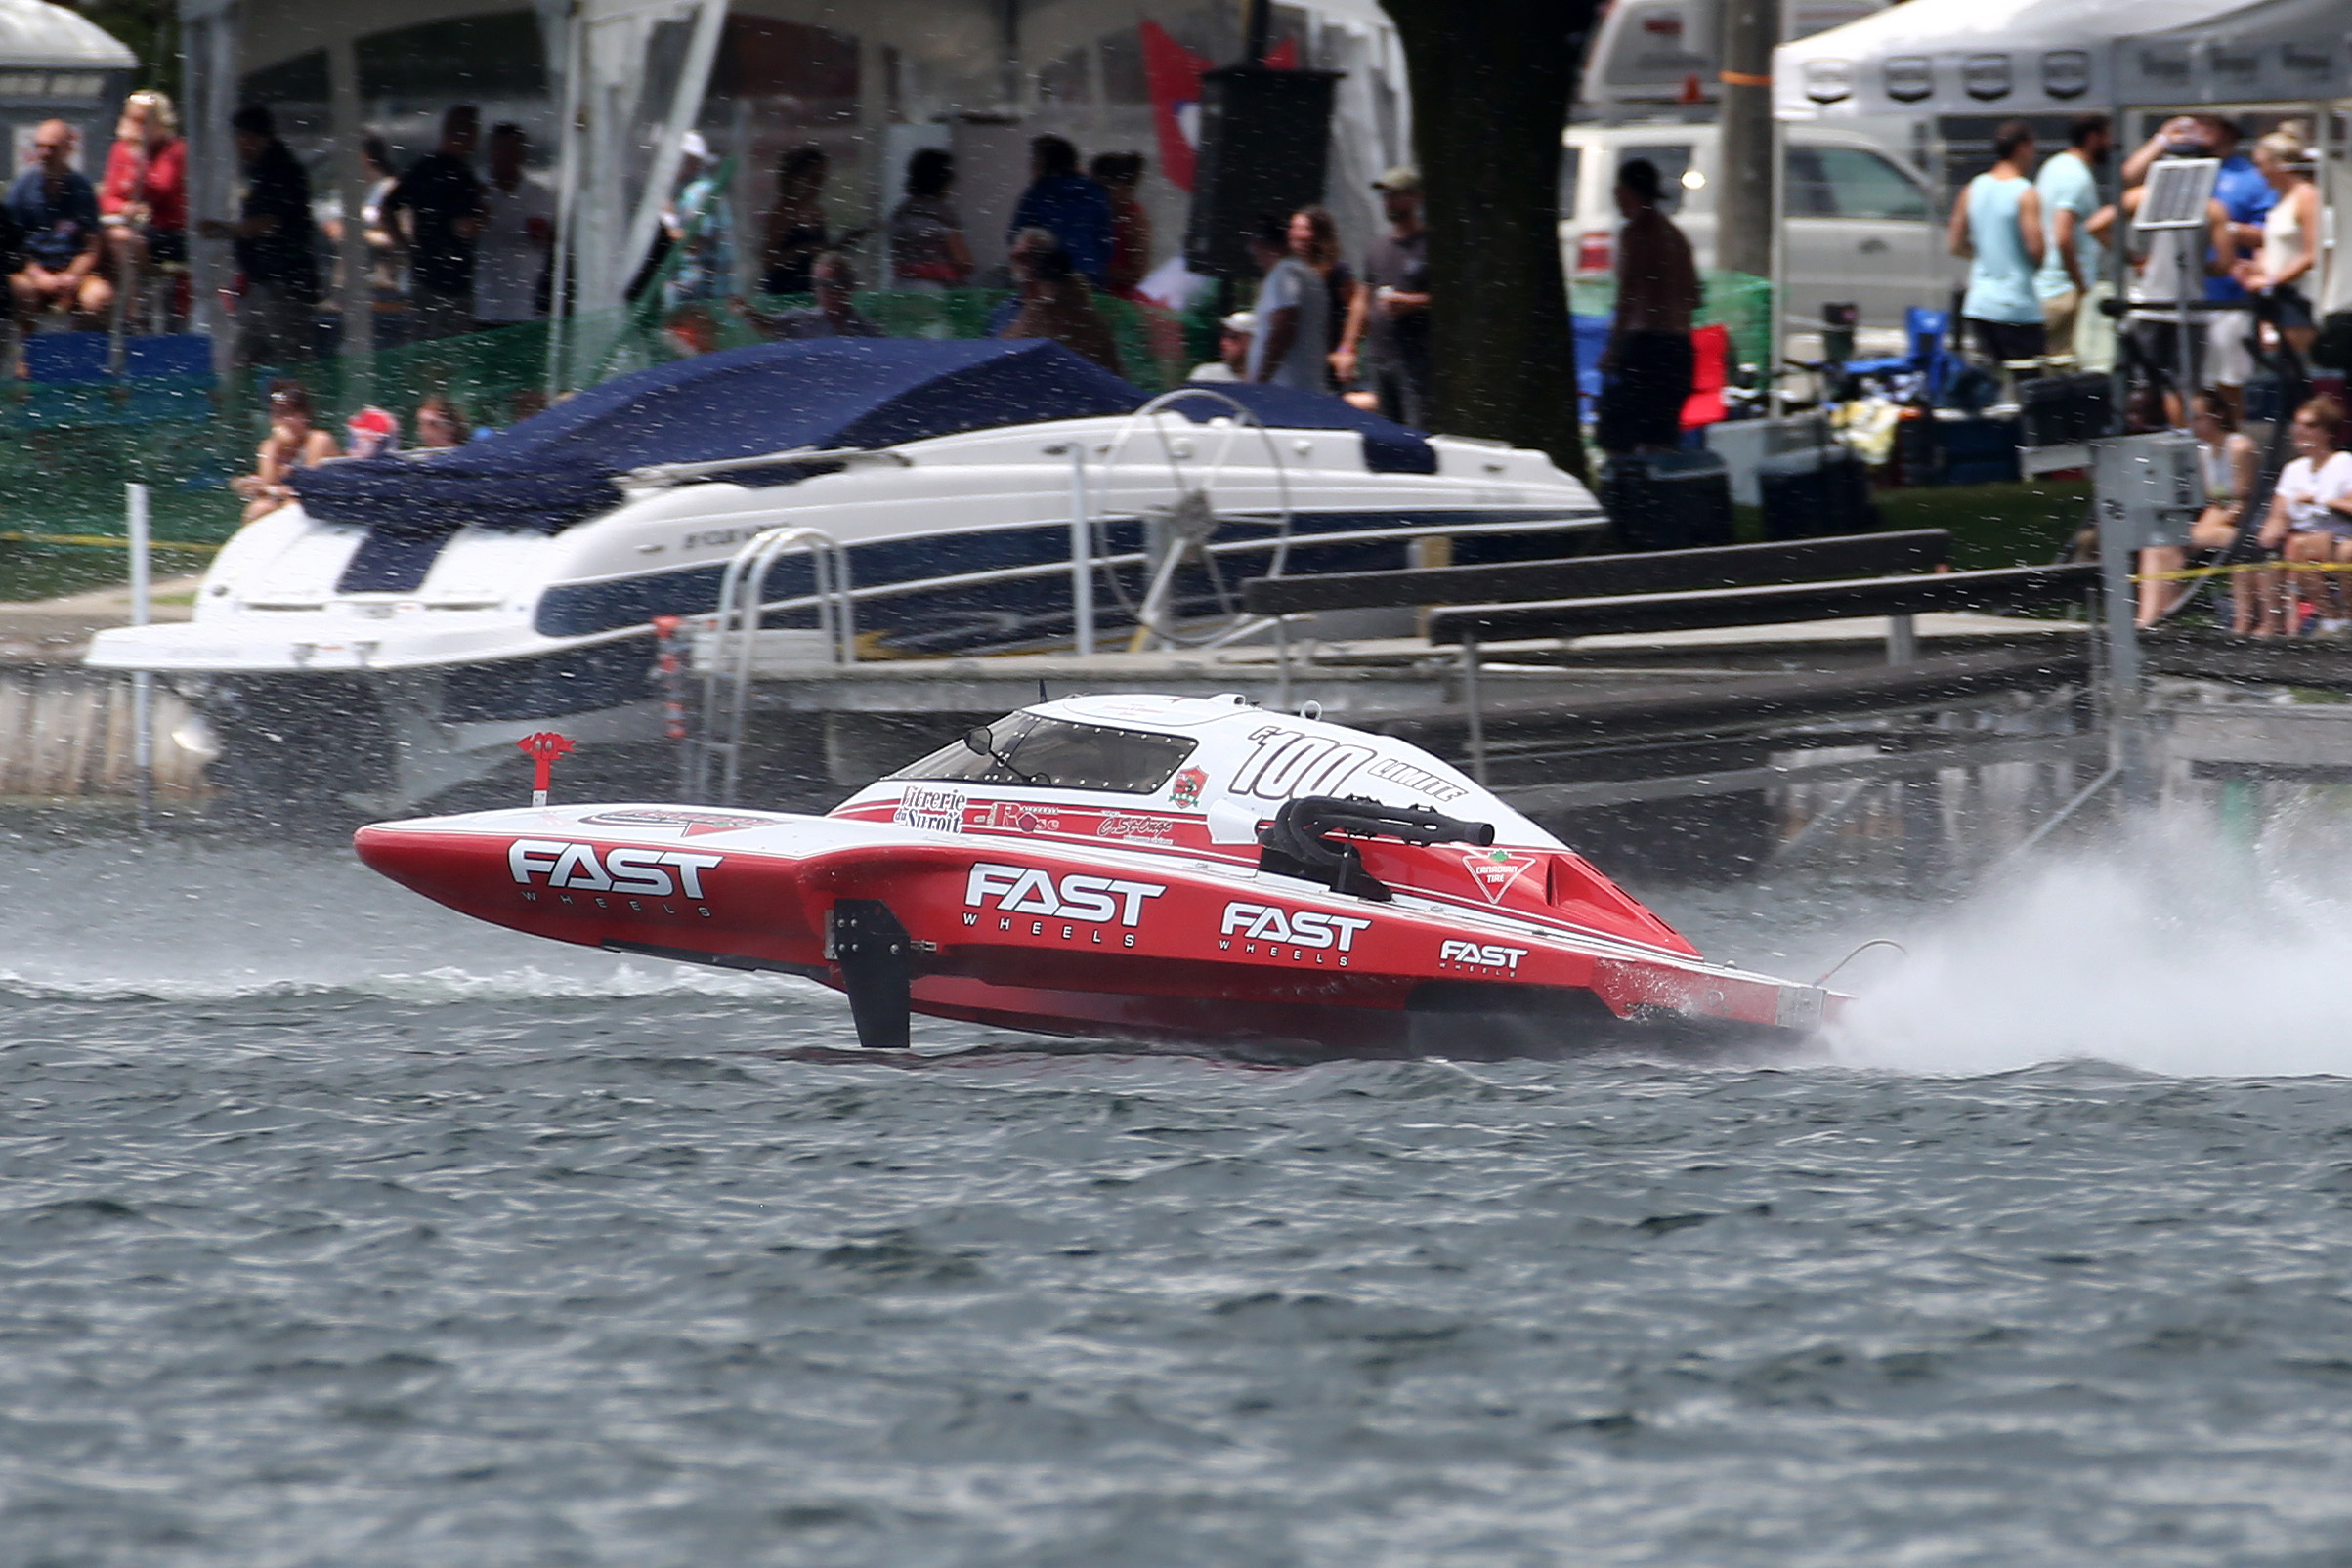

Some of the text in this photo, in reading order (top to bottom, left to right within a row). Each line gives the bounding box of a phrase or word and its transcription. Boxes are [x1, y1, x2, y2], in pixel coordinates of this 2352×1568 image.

[1368, 758, 1469, 803] LIMITE
[901, 785, 965, 811] Vitrerie
[895, 808, 907, 821] du
[508, 838, 724, 900] FAST
[1475, 866, 1518, 875] CANADIAN
[1486, 874, 1505, 883] TIRE
[521, 891, 712, 917] WHEELS
[964, 863, 1167, 927] FAST
[962, 912, 1136, 947] WHEELS
[1219, 901, 1372, 953] FAST
[1219, 940, 1348, 967] WHEELS
[1439, 939, 1529, 969] FAST
[1438, 961, 1516, 978] WHEELS
